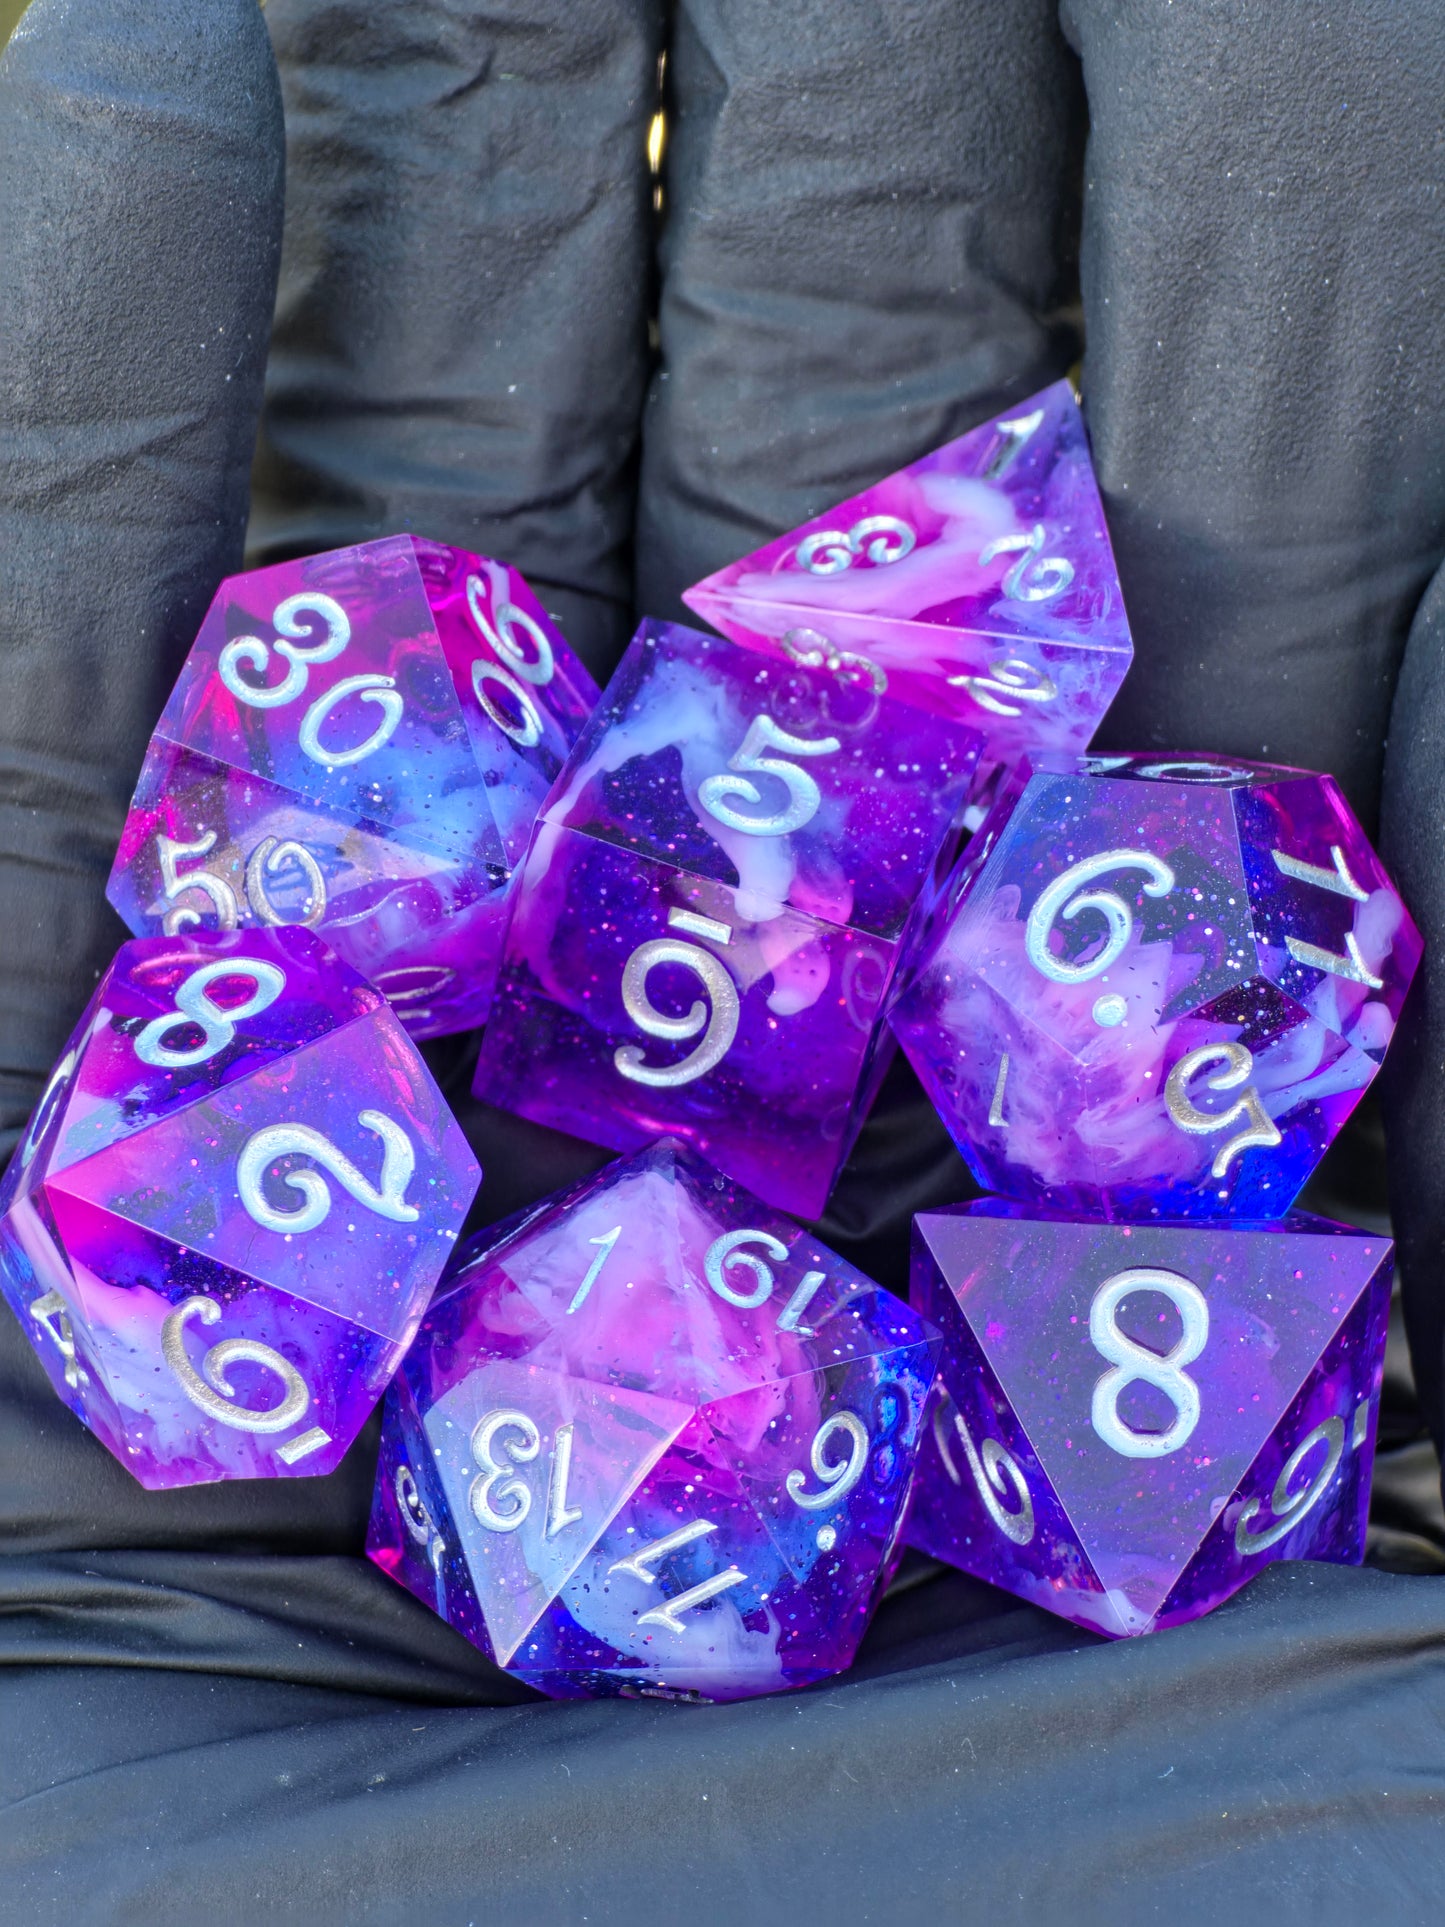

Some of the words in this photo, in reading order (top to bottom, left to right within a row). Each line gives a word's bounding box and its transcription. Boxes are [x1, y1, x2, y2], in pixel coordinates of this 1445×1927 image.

[797, 515, 917, 575] 3
[698, 714, 841, 837] 5
[134, 957, 286, 1068] 8
[237, 1109, 419, 1234] 2
[566, 1225, 622, 1314] 1
[1090, 1266, 1209, 1459] 8
